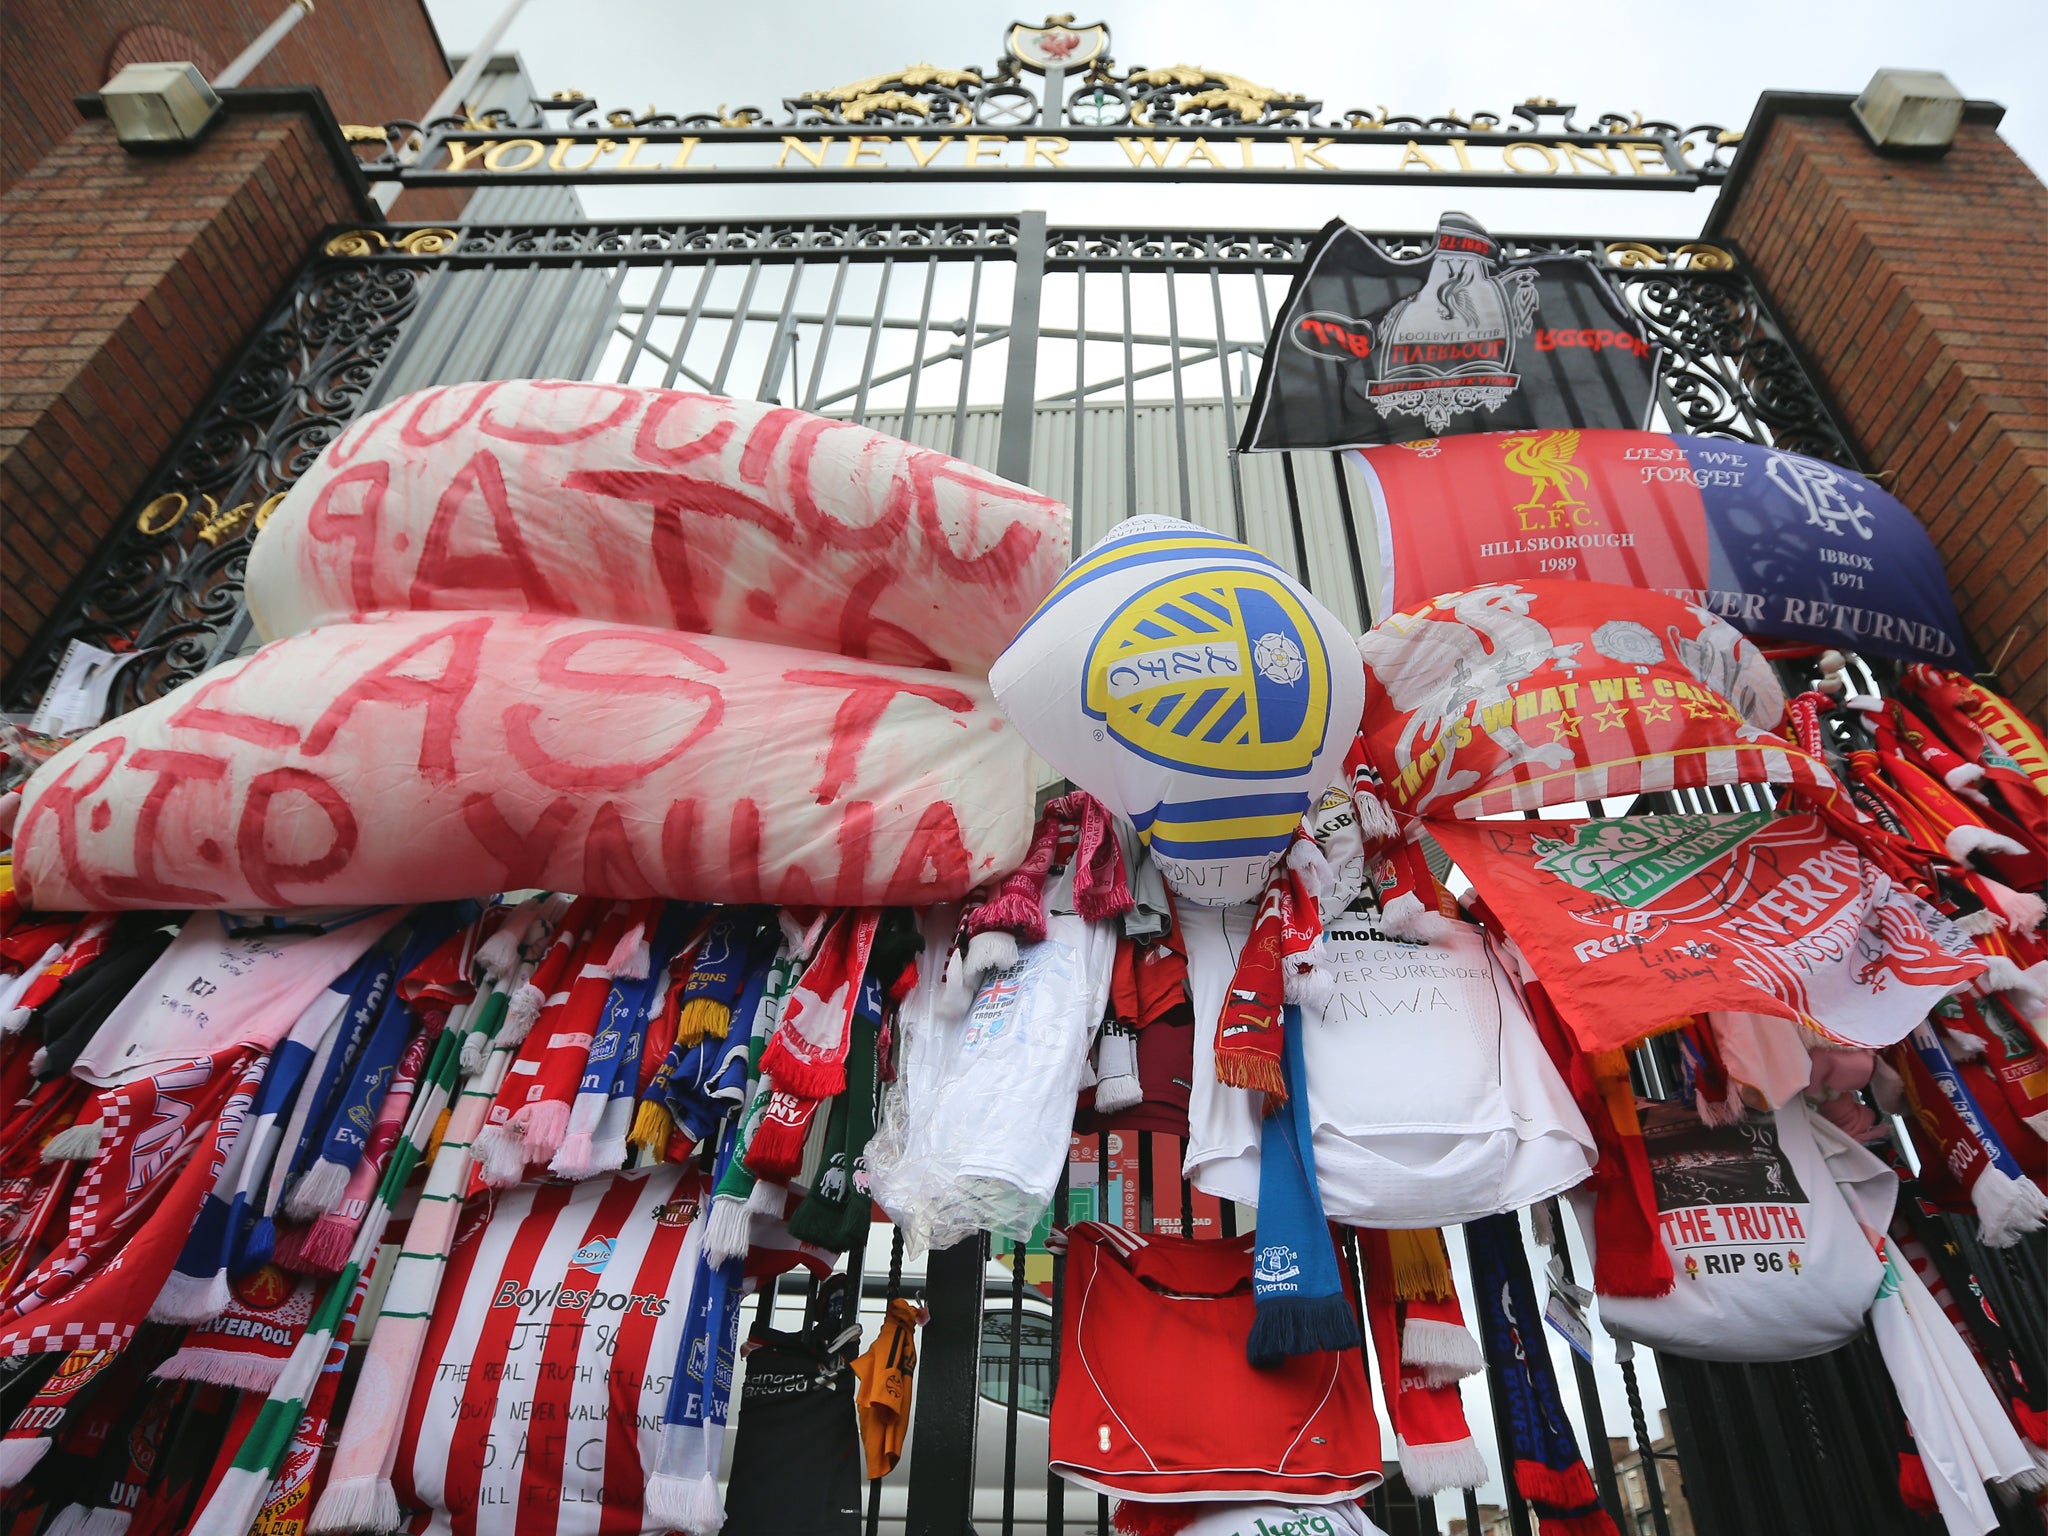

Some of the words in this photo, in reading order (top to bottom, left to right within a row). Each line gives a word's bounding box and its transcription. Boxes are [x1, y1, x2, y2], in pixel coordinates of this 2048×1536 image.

[444, 137, 716, 173] YOU'LL
[776, 135, 1072, 171] NEVER
[1115, 136, 1341, 172] WALK
[1399, 137, 1683, 178] ALONE
[1623, 446, 1688, 463] LEST
[1699, 450, 1749, 469] WE
[1641, 465, 1745, 489] FORGET
[1519, 506, 1600, 532] L.F.C.
[1479, 532, 1636, 558] HILLSBOROUGH
[1539, 555, 1578, 574] 1989
[1818, 547, 1875, 572] IBROX
[1830, 570, 1866, 590] 1971
[1782, 596, 1957, 658] RETURNED
[1391, 715, 1474, 807] THAT'S
[1481, 681, 1580, 735] WHAT
[1591, 676, 1646, 702] WE
[1373, 949, 1420, 963] GIVE
[1425, 952, 1450, 962] UP
[1379, 964, 1493, 980] SURRENDER
[1659, 1208, 1717, 1246] THE
[1716, 1205, 1807, 1241] TRUTH
[576, 1248, 612, 1261] Boyle
[1703, 1253, 1746, 1275] RIP
[1753, 1251, 1784, 1273] 96
[493, 1280, 670, 1318] Boylesports
[1255, 1282, 1299, 1296] Everton
[195, 1316, 293, 1347] LIVERPOOL
[595, 1325, 621, 1357] 96
[438, 1363, 471, 1383] THE
[483, 1361, 526, 1383] REAL
[535, 1362, 593, 1384] TRUTH
[603, 1369, 626, 1387] AT
[629, 1373, 673, 1395] LAST
[509, 1400, 557, 1422] NEVER
[563, 1400, 611, 1422] WALK
[457, 1484, 511, 1506] WILL
